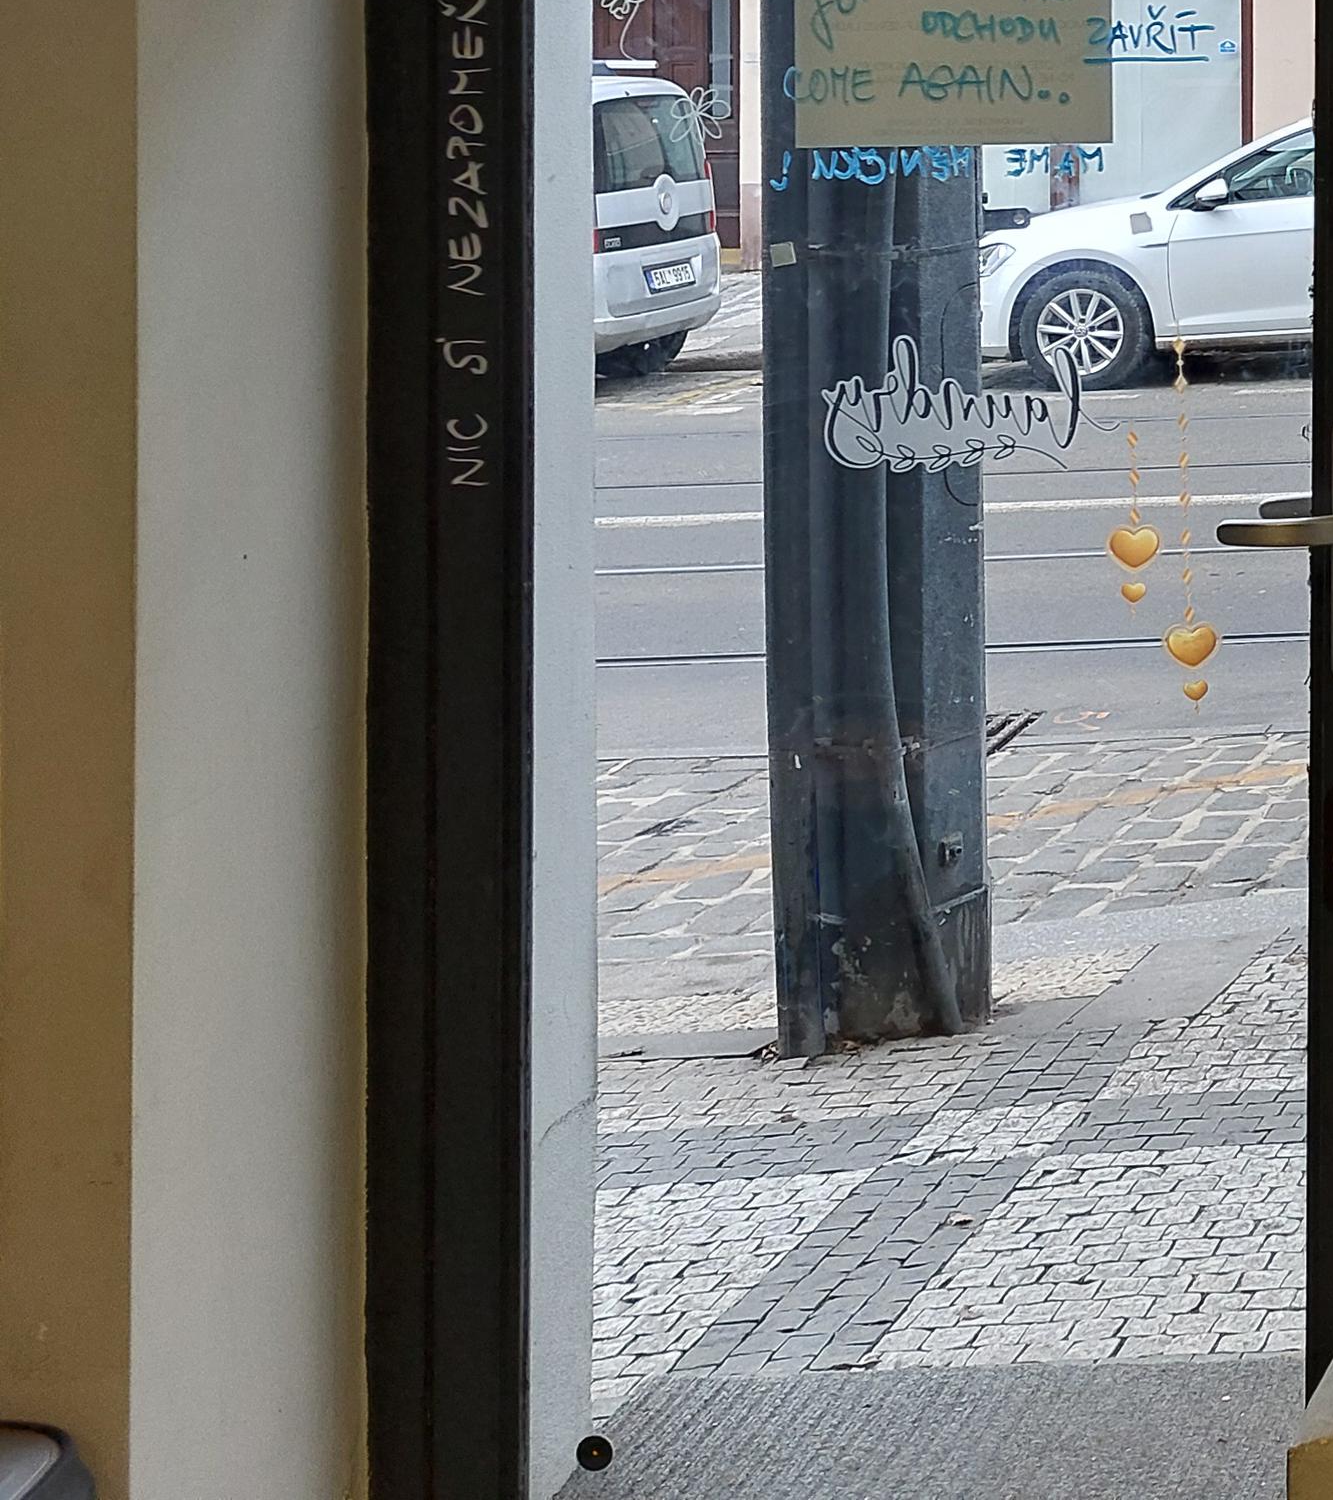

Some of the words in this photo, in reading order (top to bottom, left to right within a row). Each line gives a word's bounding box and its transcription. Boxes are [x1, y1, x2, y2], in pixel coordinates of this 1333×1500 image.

[921, 11, 1062, 46] ODCHODU
[782, 65, 878, 107] COME
[446, 412, 490, 487] NIC
